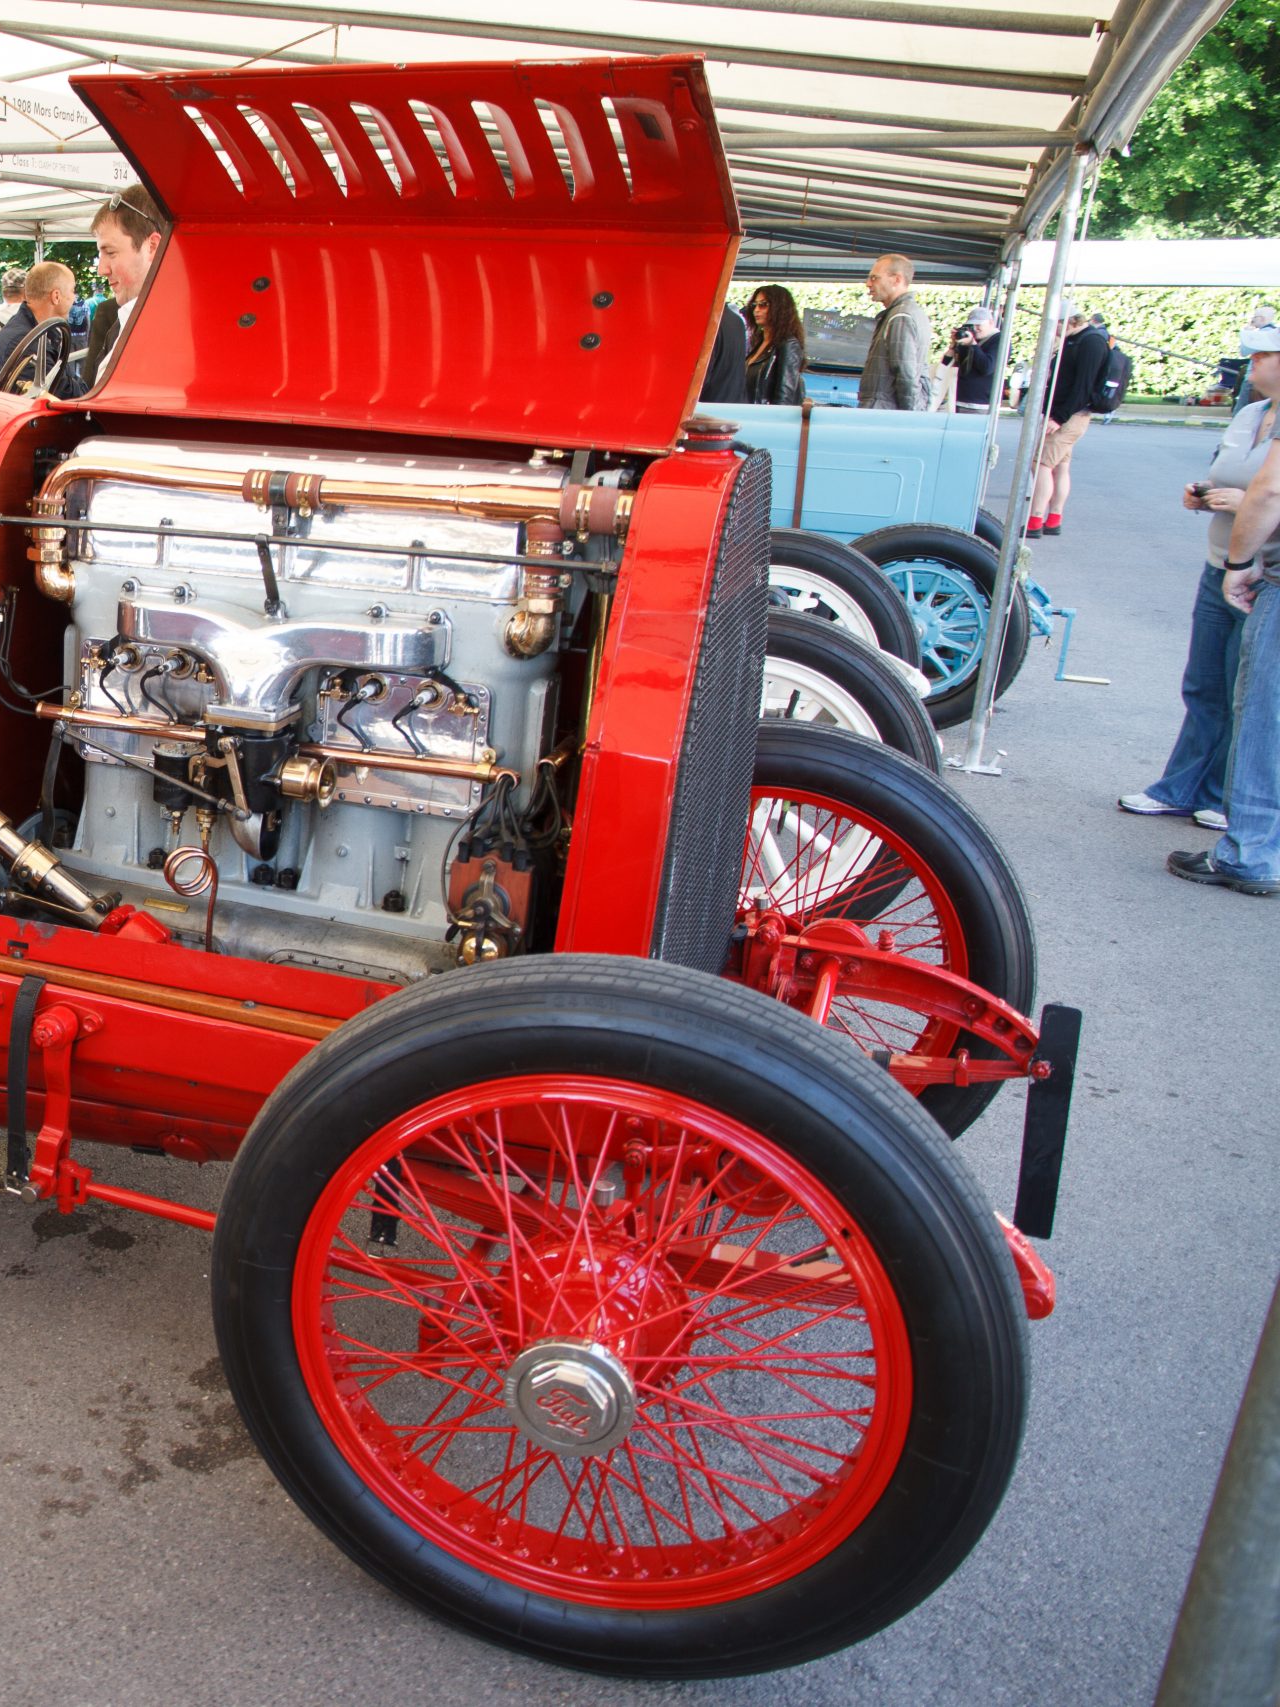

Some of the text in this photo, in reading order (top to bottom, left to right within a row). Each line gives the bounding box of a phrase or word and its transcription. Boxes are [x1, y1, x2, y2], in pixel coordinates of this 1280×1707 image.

[13, 97, 32, 114] 1908
[53, 106, 74, 122] Grand
[77, 110, 88, 124] Prix
[12, 153, 29, 167] Class
[113, 168, 128, 180] 314
